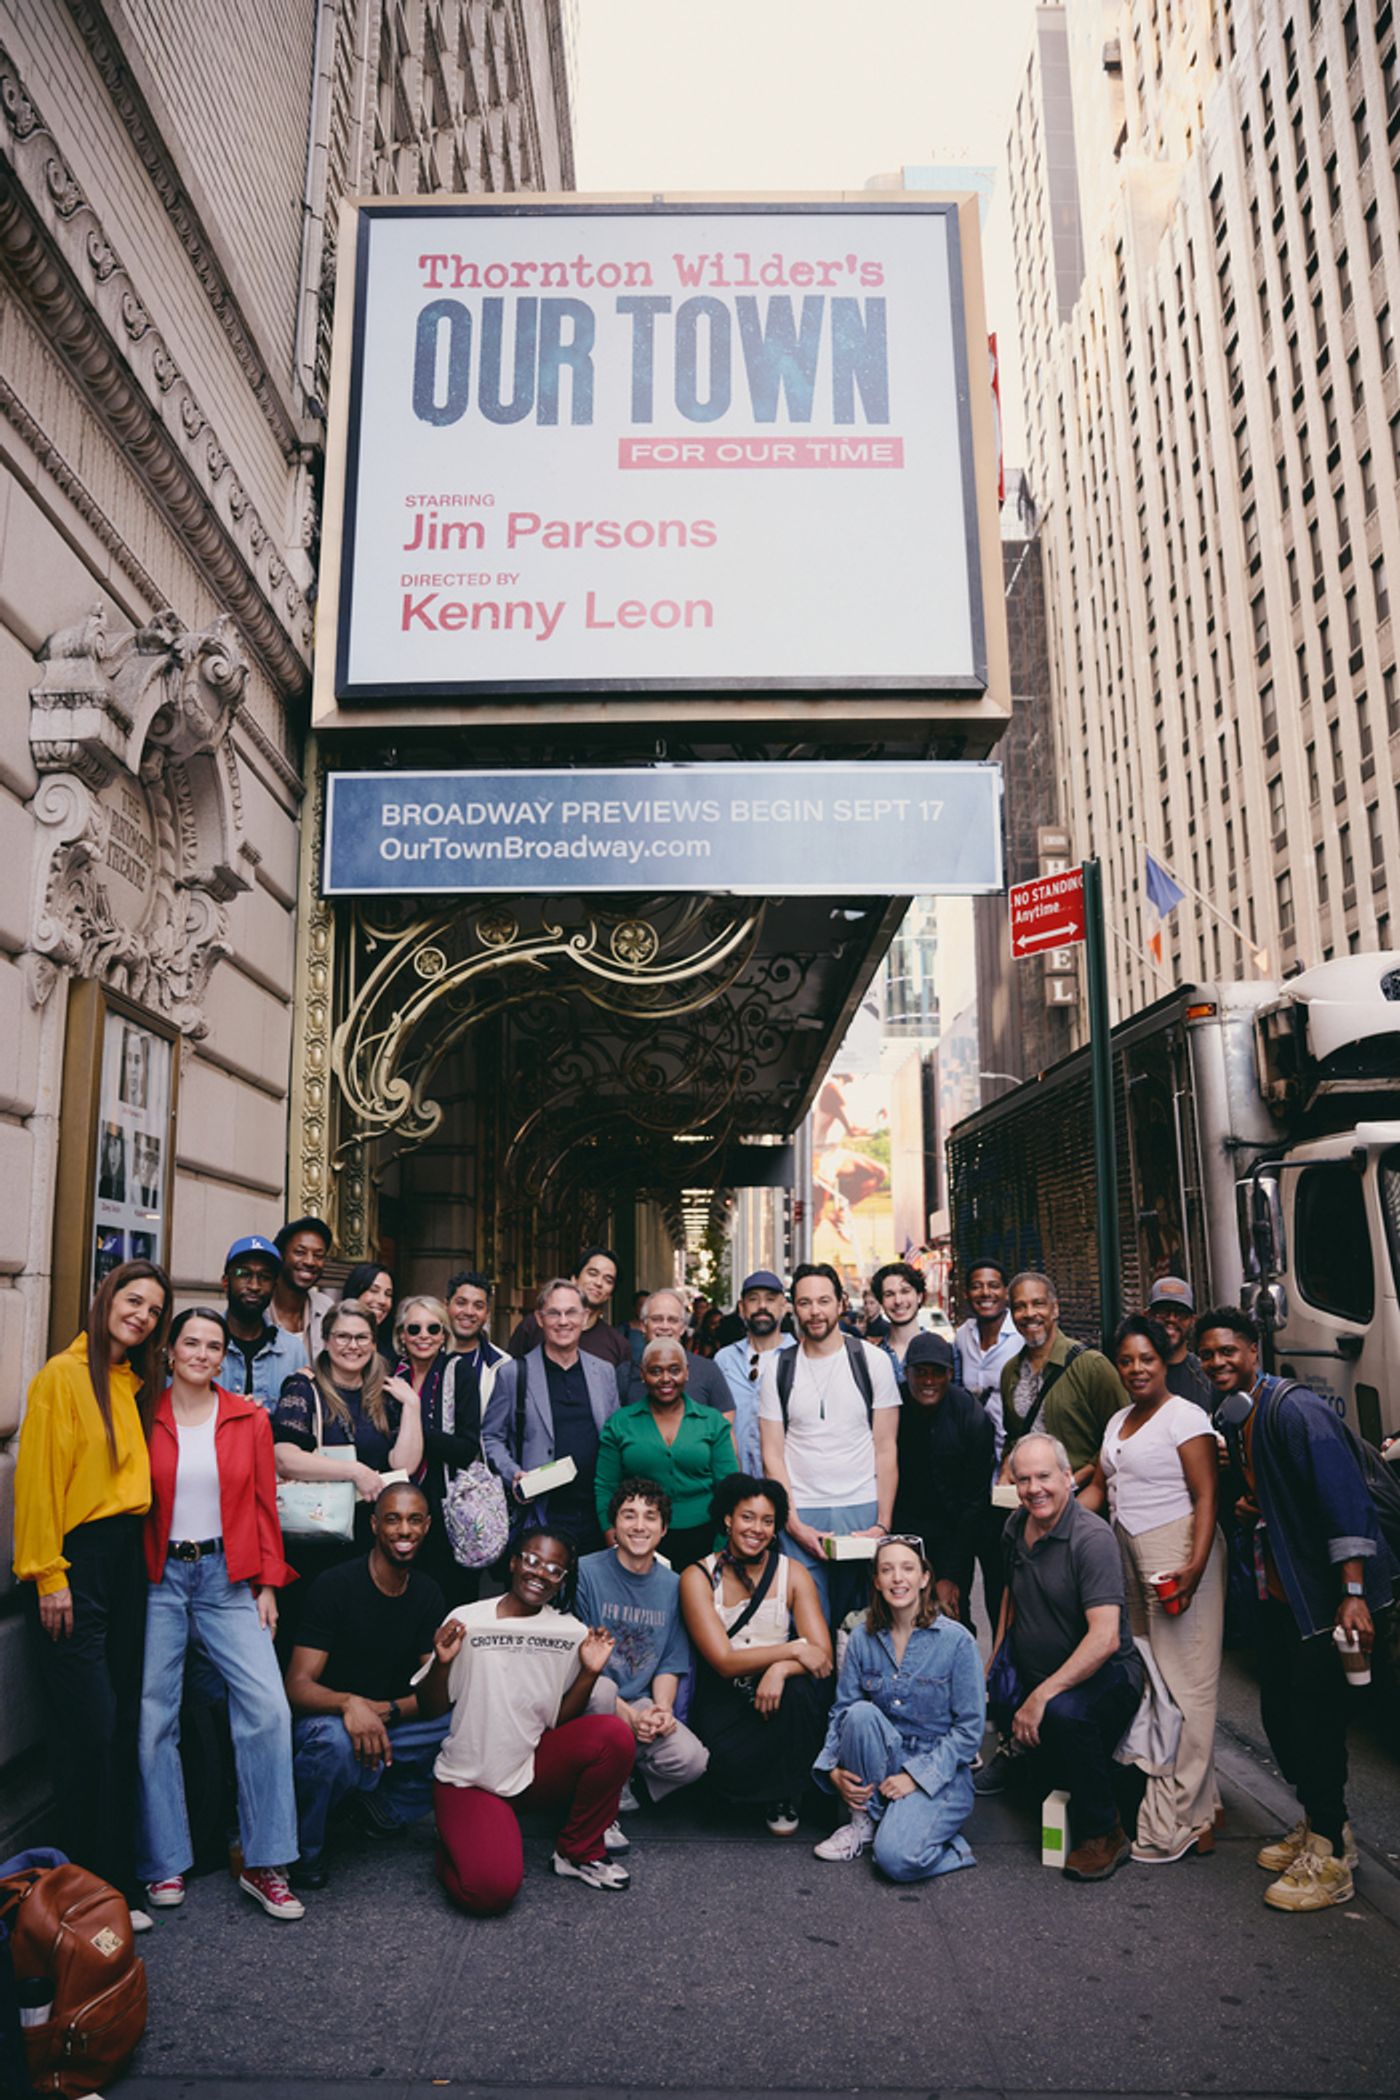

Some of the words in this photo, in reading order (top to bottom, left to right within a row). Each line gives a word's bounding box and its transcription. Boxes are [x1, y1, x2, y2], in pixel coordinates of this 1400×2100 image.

[419, 253, 653, 288] Thornton
[672, 252, 884, 288] Wilder's
[412, 296, 595, 427] OUR
[616, 295, 890, 425] TOWN
[631, 444, 705, 462] FOR
[716, 443, 795, 462] OUR
[806, 442, 894, 462] TIME
[404, 493, 496, 508] STARRING
[403, 511, 485, 552] Jim
[506, 511, 717, 549] Parsons
[400, 573, 492, 588] DIRECTED
[496, 572, 520, 586] BY
[401, 592, 566, 641] Kenny
[585, 591, 714, 629] Leon
[381, 801, 554, 826] BROADWAY
[561, 799, 721, 824] PREVIEWS
[730, 799, 824, 822] BEGIN
[832, 799, 911, 822] SEPT
[918, 800, 945, 822] 17
[379, 834, 712, 864] OurTownBroadway.com
[1013, 891, 1029, 907] NO
[1015, 902, 1060, 924] Anytime
[527, 1635, 576, 1651] CORNERS
